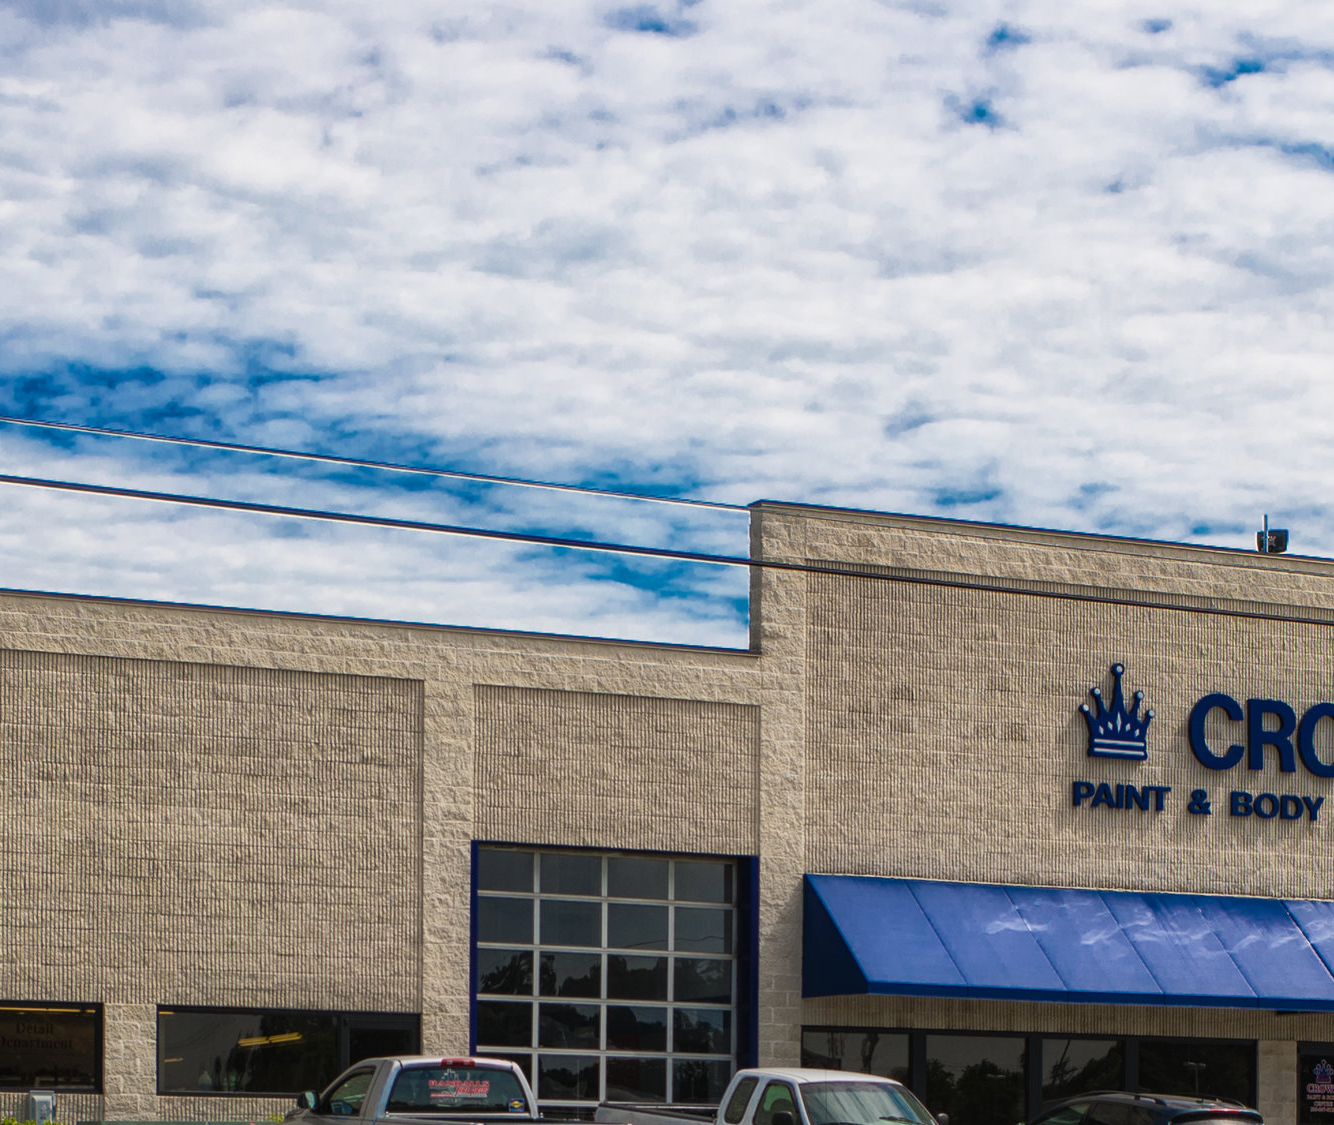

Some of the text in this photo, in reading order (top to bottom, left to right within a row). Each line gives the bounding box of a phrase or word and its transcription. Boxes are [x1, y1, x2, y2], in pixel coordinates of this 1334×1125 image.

[1072, 781, 1171, 812] PAINT
[1187, 789, 1212, 815] &
[1230, 791, 1324, 821] BODY
[16, 1022, 54, 1034] Detail
